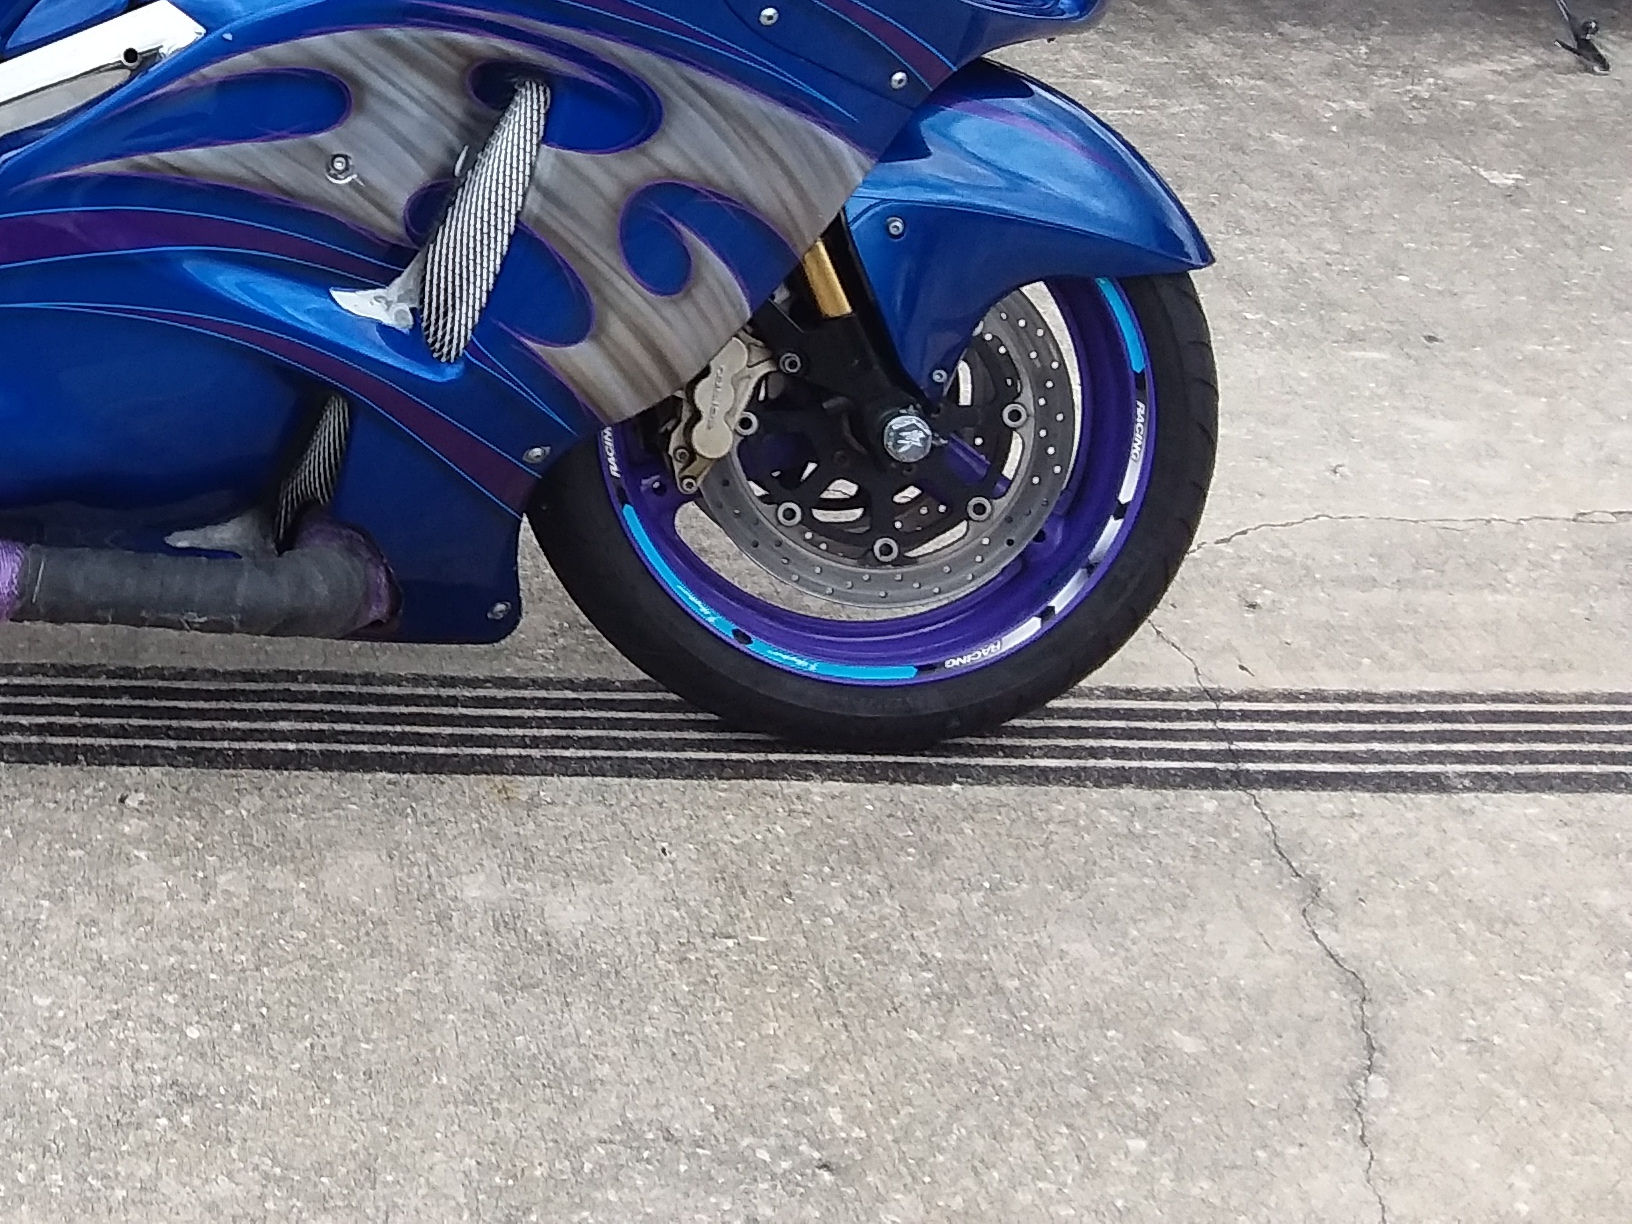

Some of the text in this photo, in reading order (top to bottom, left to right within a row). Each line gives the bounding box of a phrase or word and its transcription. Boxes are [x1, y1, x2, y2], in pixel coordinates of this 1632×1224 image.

[602, 426, 621, 478] RACIN
[1130, 399, 1147, 463] RACING
[944, 639, 1002, 669] RACING
